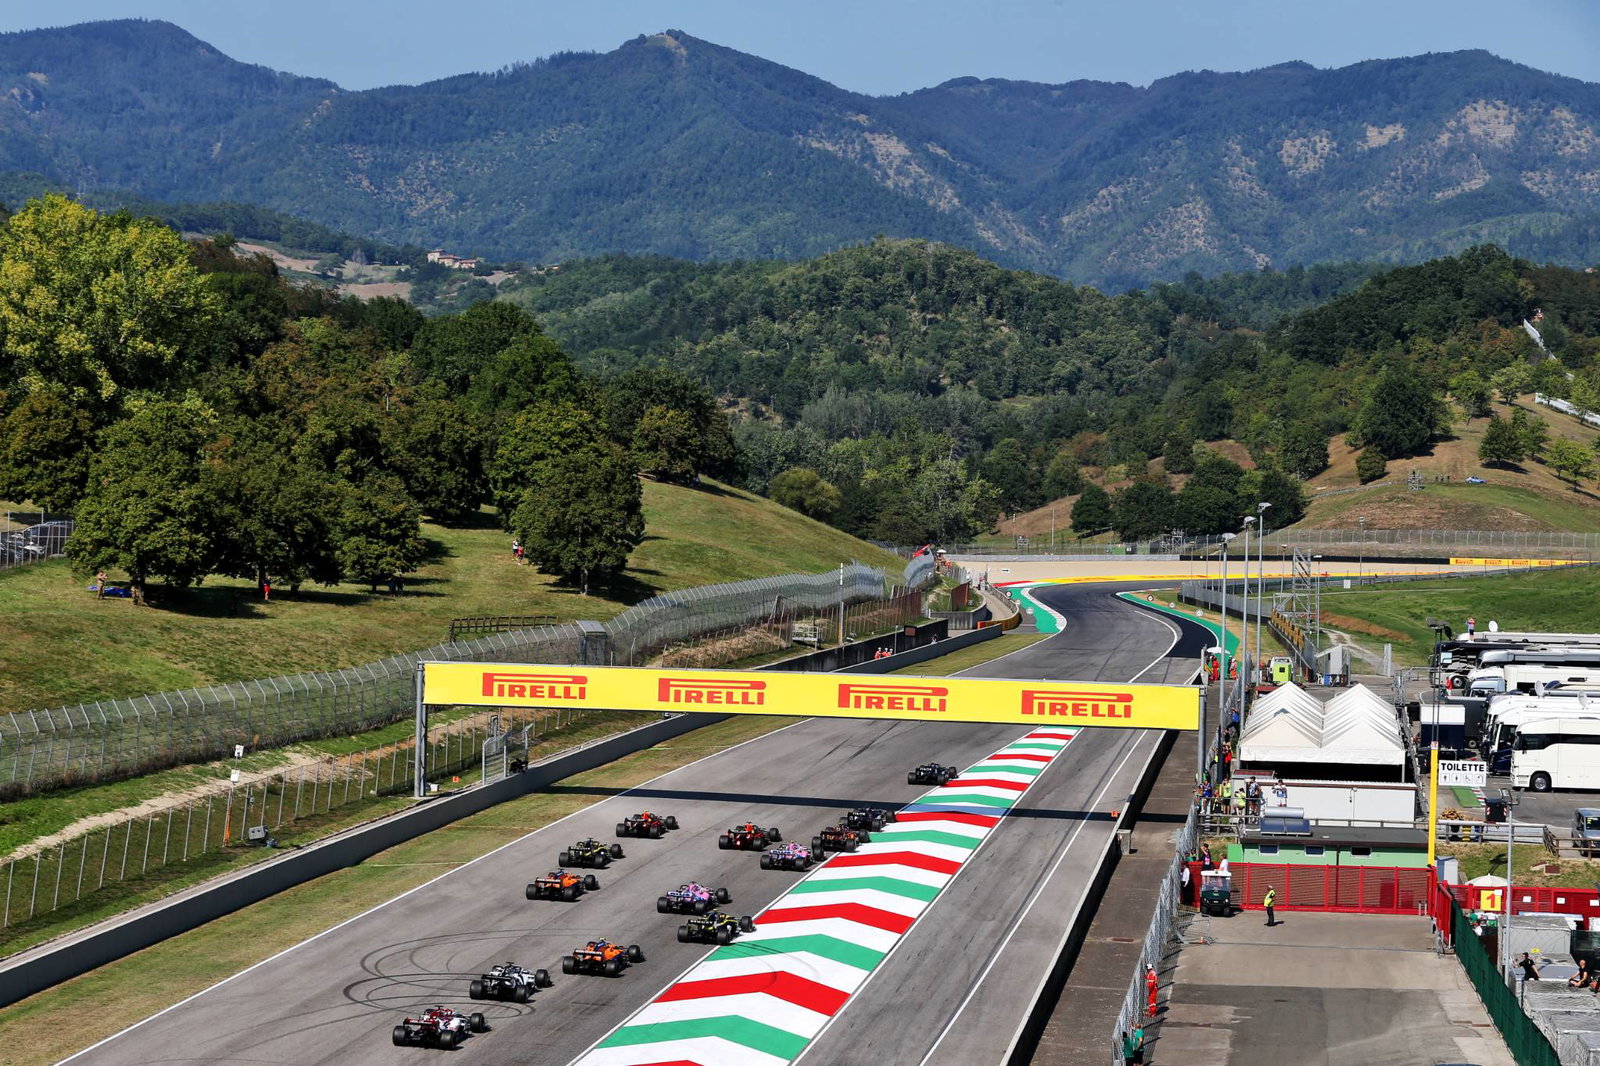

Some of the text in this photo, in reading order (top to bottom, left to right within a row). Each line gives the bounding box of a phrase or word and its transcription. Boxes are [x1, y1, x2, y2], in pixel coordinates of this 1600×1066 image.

[483, 673, 587, 699] PIRELLI
[659, 678, 766, 704] PIRELLI
[838, 684, 948, 711] PIRELLI
[1022, 690, 1133, 717] PIRELLI
[1441, 762, 1485, 772] TOILETTE
[1486, 894, 1496, 909] 1
